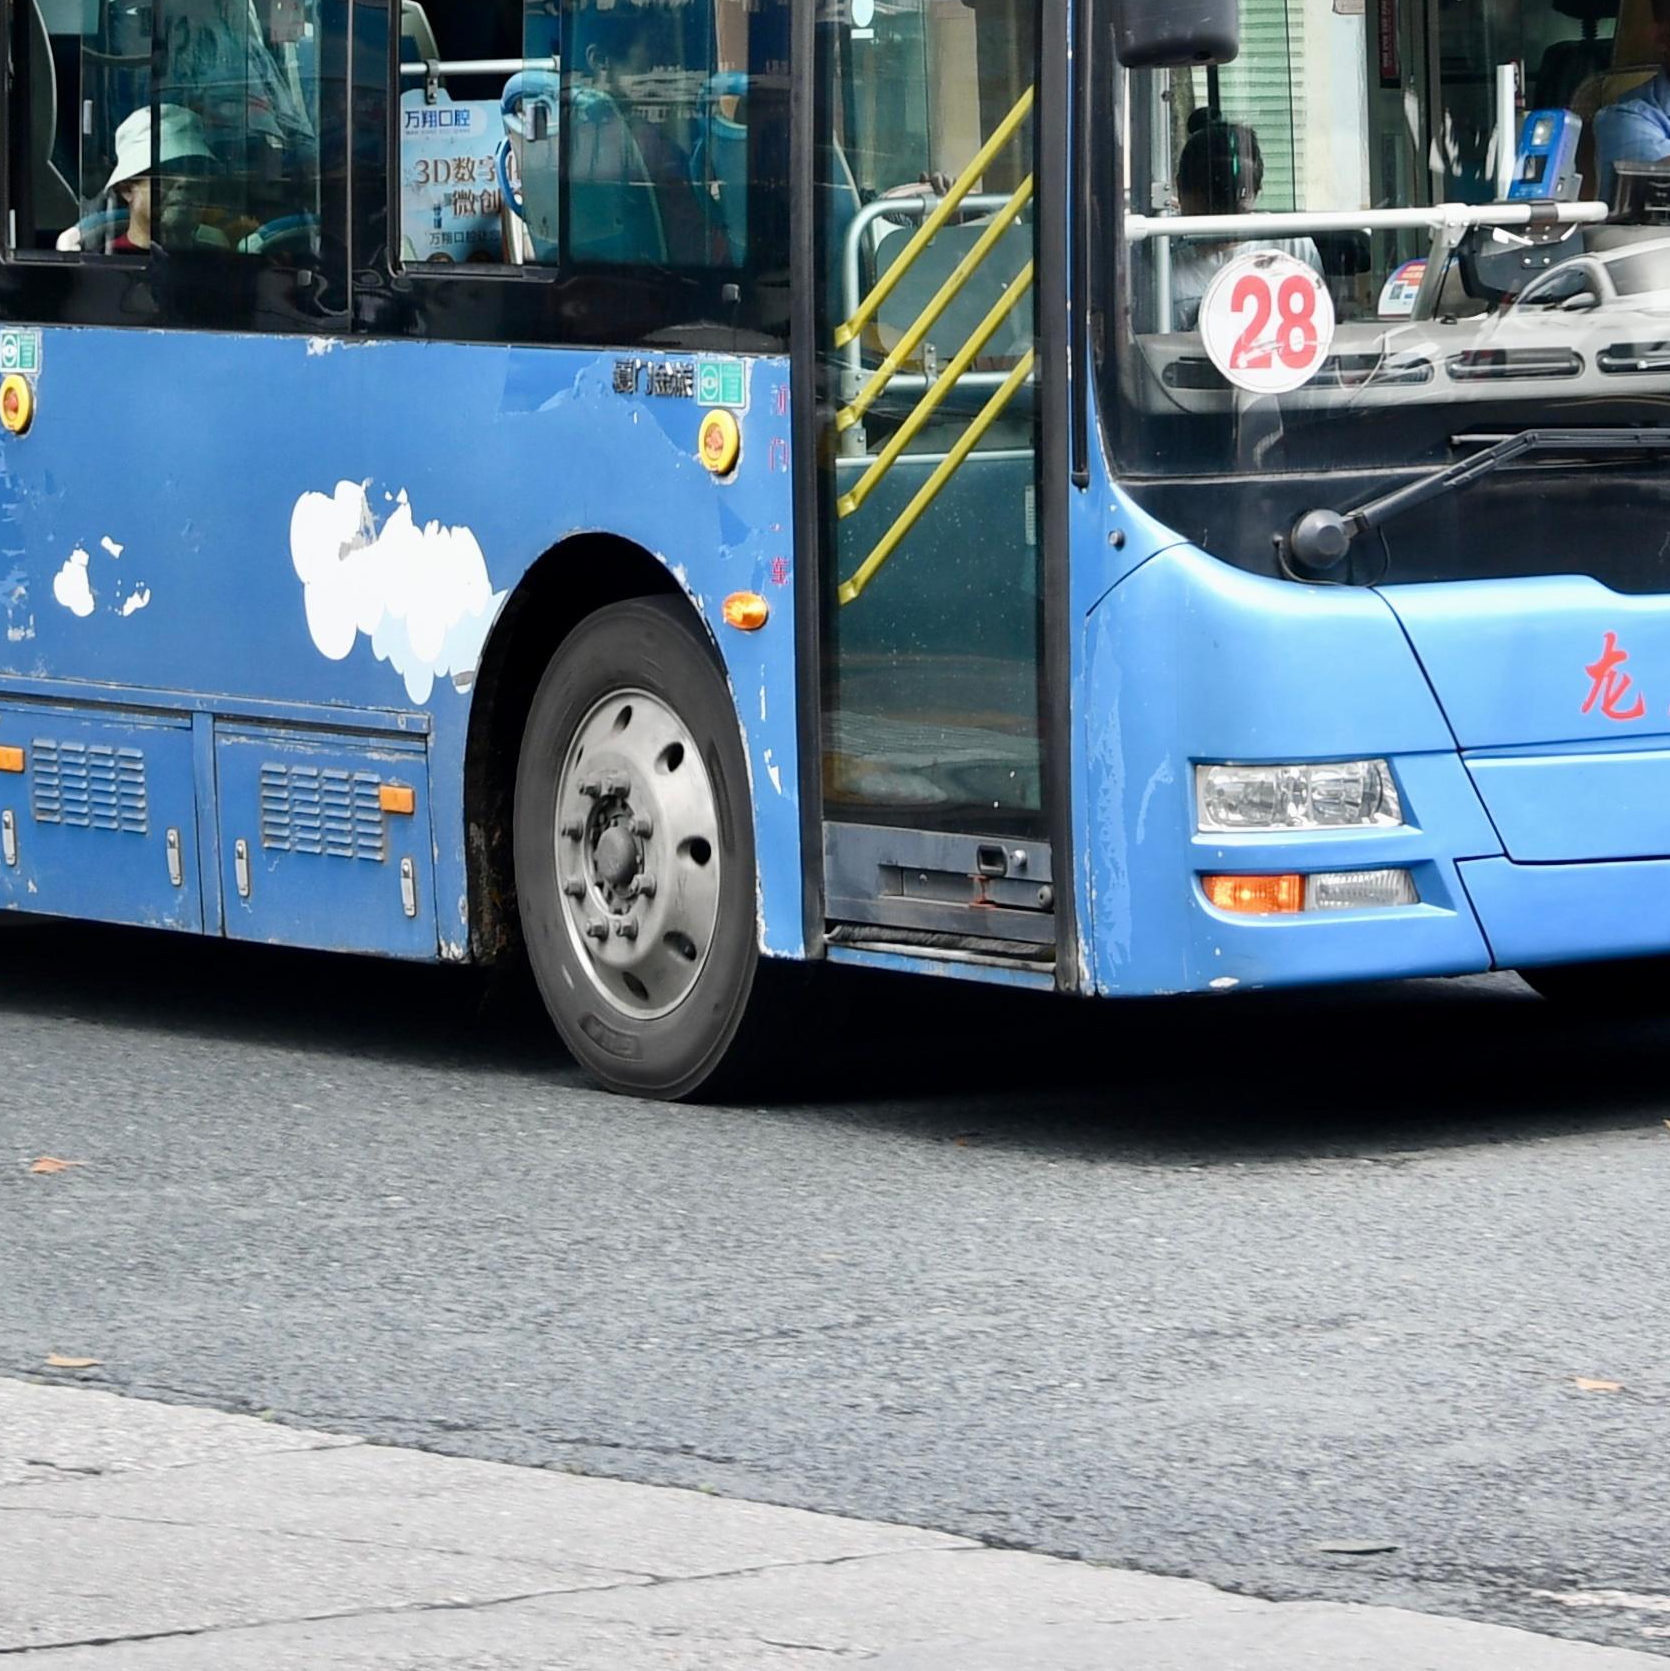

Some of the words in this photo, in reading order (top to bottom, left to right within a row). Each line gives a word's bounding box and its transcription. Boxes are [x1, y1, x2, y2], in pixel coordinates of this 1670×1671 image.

[404, 109, 471, 129] 万翔口腔
[1227, 270, 1321, 371] 28
